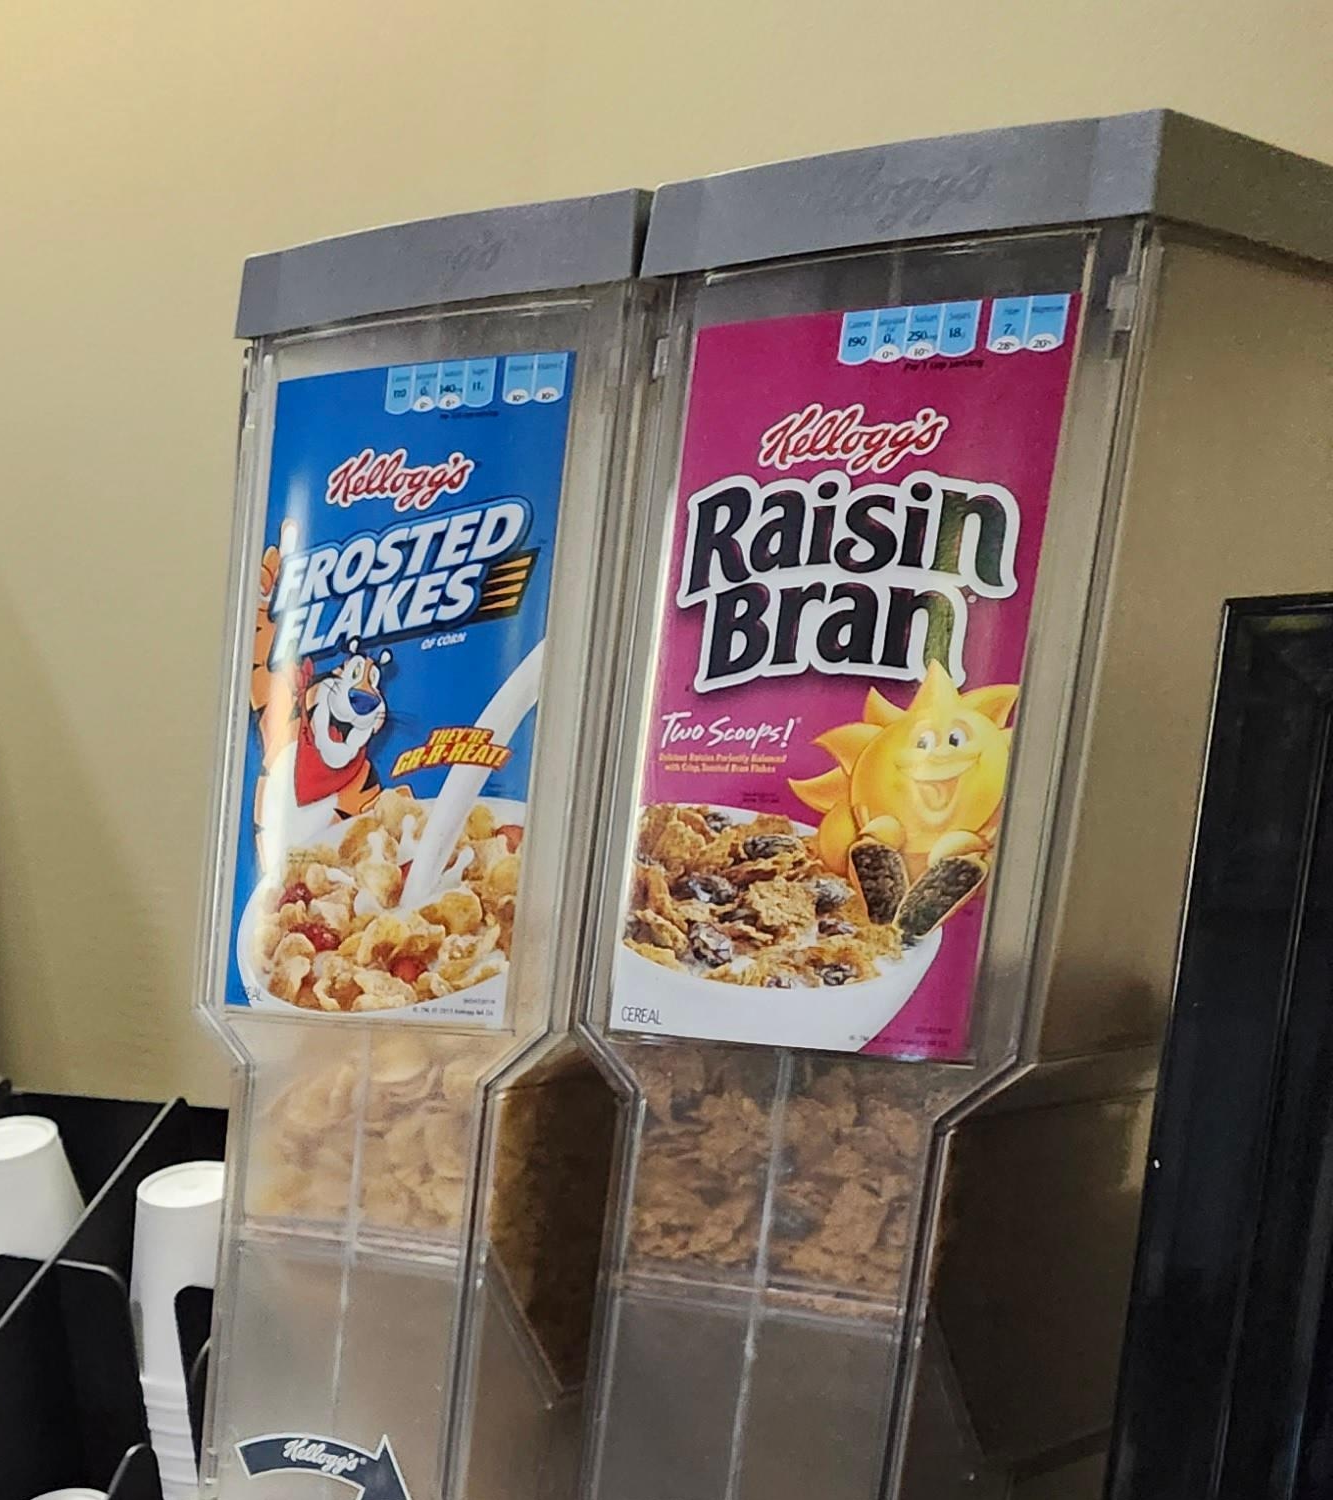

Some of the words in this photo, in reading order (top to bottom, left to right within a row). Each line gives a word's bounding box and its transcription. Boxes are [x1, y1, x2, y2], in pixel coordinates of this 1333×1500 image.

[847, 336, 867, 347] 190
[761, 406, 947, 472] Kellogg's
[327, 449, 474, 511] Kellogg's
[272, 501, 526, 612] FROSTED
[686, 482, 1007, 597] Raisin
[270, 564, 485, 666] FLAKES
[437, 632, 467, 649] CORN
[705, 581, 953, 680] Bran
[661, 711, 704, 748] Two
[706, 716, 795, 748] Scoops!
[621, 1006, 662, 1026] CEREAL
[283, 1439, 359, 1474] Kellogg's
